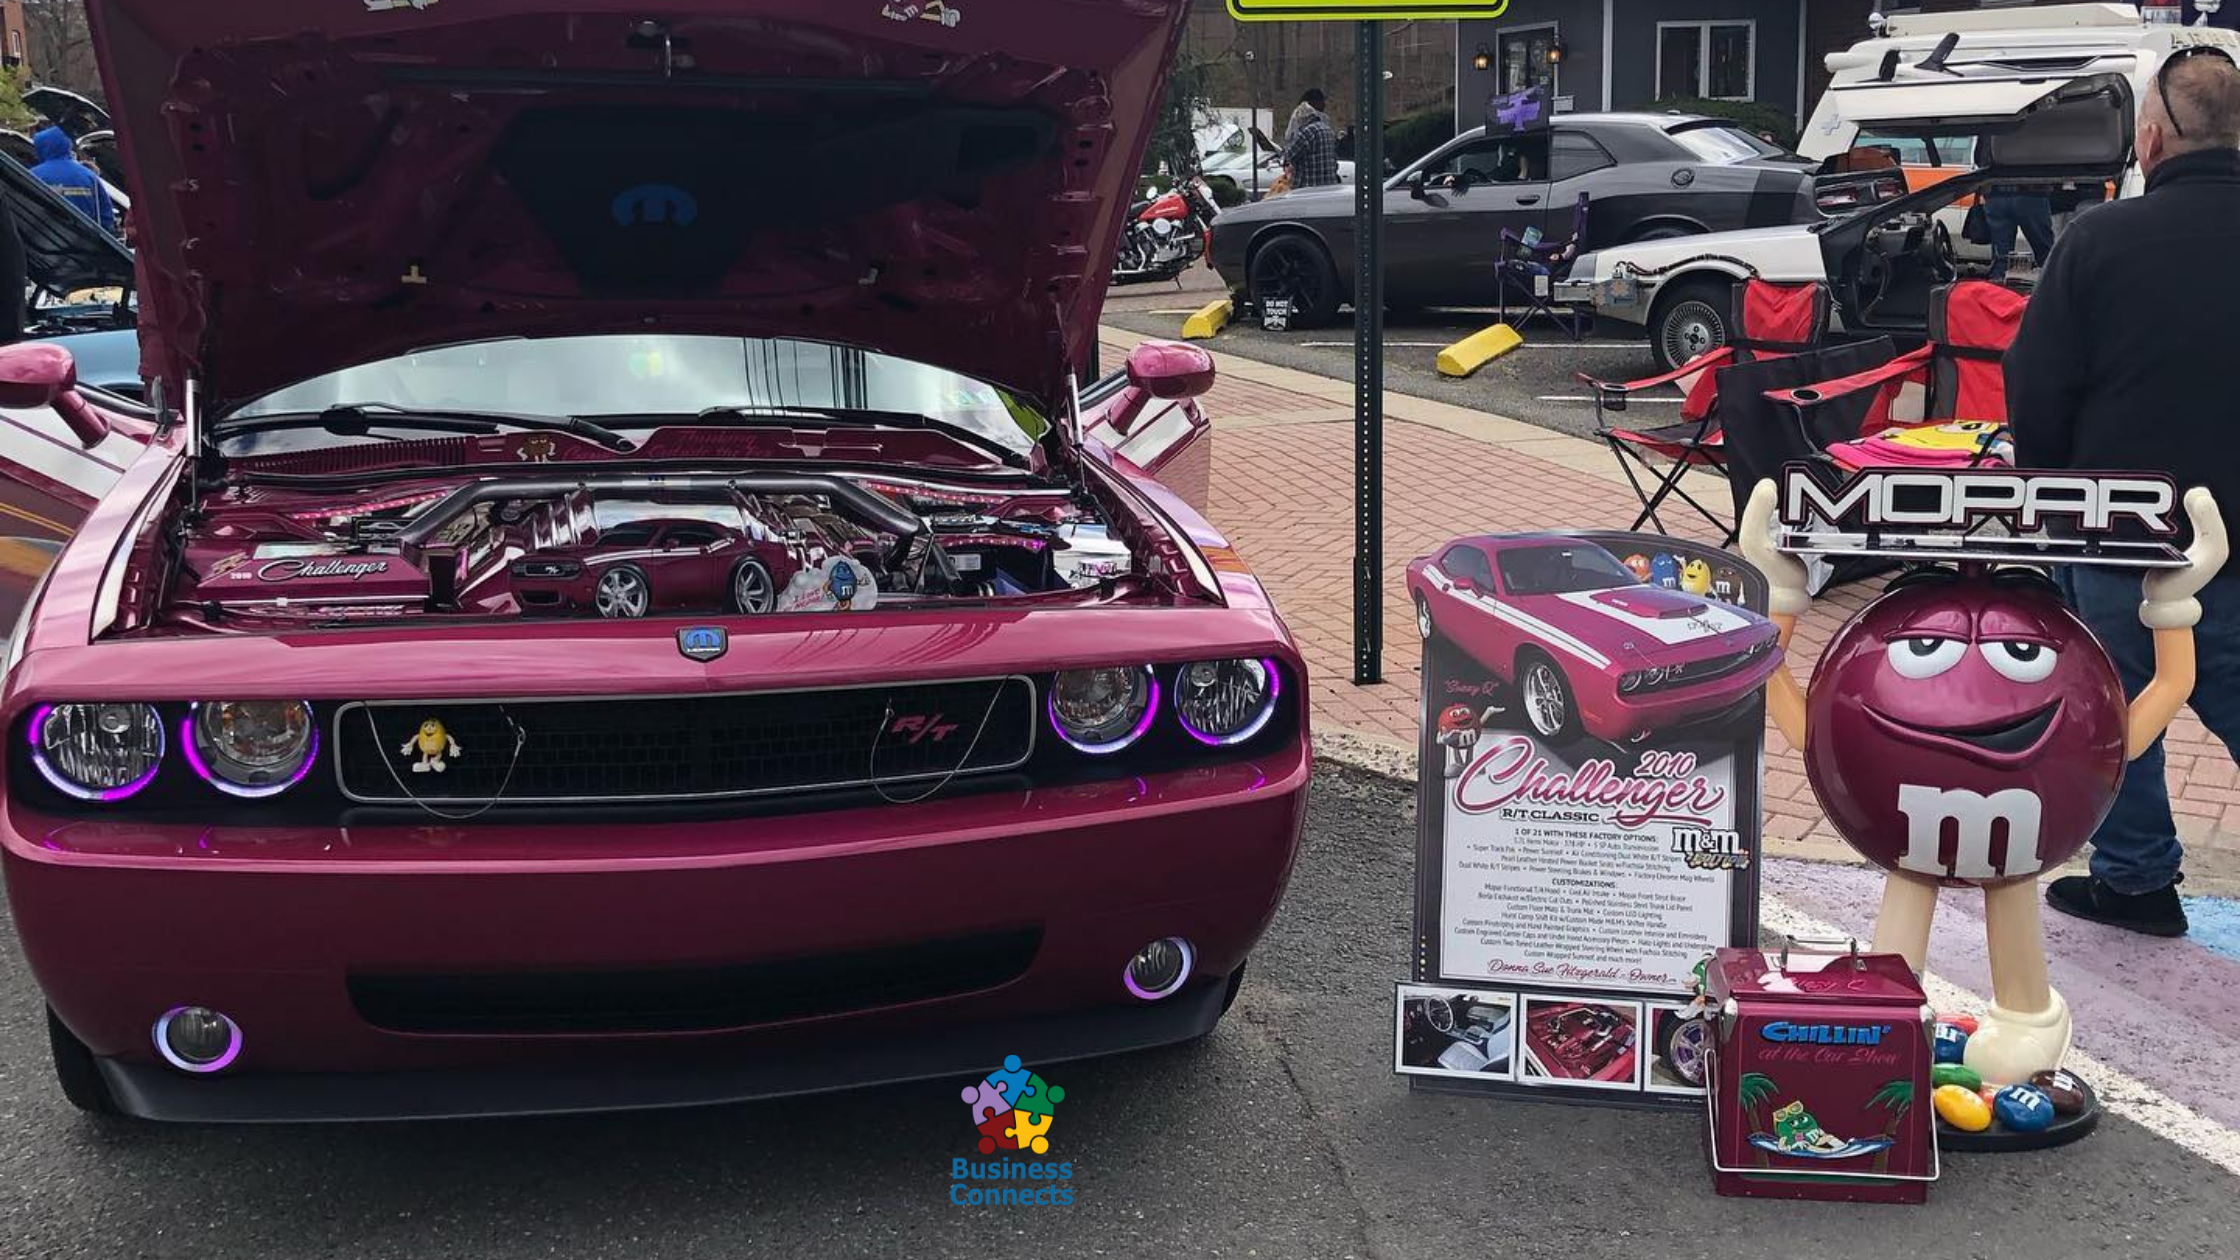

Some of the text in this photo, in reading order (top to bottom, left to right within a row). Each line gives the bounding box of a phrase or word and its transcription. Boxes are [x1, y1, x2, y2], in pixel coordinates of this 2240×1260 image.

[1786, 471, 2175, 532] MOPAR
[257, 559, 388, 581] Challenger
[892, 713, 959, 744] R/T
[1635, 751, 1698, 778] 2010
[1456, 736, 1726, 827] Challenger
[1502, 808, 1600, 823] R/T CLASSIC
[1520, 827, 1531, 836] OF
[1532, 828, 1542, 837] 21
[1543, 829, 1563, 838] WITH
[1564, 830, 1587, 840] THESE
[1589, 831, 1621, 842] FACTORY
[1897, 783, 2042, 879] m
[1472, 843, 1488, 853] Super
[1522, 846, 1539, 854] Power
[1580, 849, 1616, 860] Conditioning
[1632, 852, 1649, 861] White
[1516, 855, 1537, 863] Leather
[1560, 857, 1577, 866] Power
[1458, 860, 1472, 869] Dual
[1472, 861, 1489, 870] White
[1528, 864, 1546, 873] Power
[1547, 865, 1571, 876] Steering
[1600, 868, 1625, 877] Windows
[1634, 870, 1656, 881] Factory
[1656, 872, 1678, 880] Chrome
[1503, 884, 1532, 893] Functional
[1551, 877, 1618, 889] CUSTOMIZATIONS:
[1506, 902, 1528, 911] Custom
[1602, 908, 1624, 917] Custom
[1454, 926, 1475, 935] Custom
[1475, 927, 1502, 938] Engraved
[1671, 940, 1683, 948] and
[1514, 920, 1526, 928] and
[1527, 921, 1542, 929] Hand
[1542, 922, 1564, 931] Painted
[1565, 924, 1590, 934] Graphics
[1598, 926, 1619, 934] Custom
[1620, 927, 1642, 936] Leather
[1665, 930, 1677, 938] and
[1480, 937, 1502, 945] Custom
[1555, 942, 1579, 952] Wrapped
[1524, 949, 1545, 958] Custom
[1487, 958, 1668, 984] Donna Sue Fitzgerald Owner
[1760, 1021, 1892, 1046] CHILLIN'
[1758, 1047, 1777, 1061] at
[1782, 1047, 1809, 1061] the
